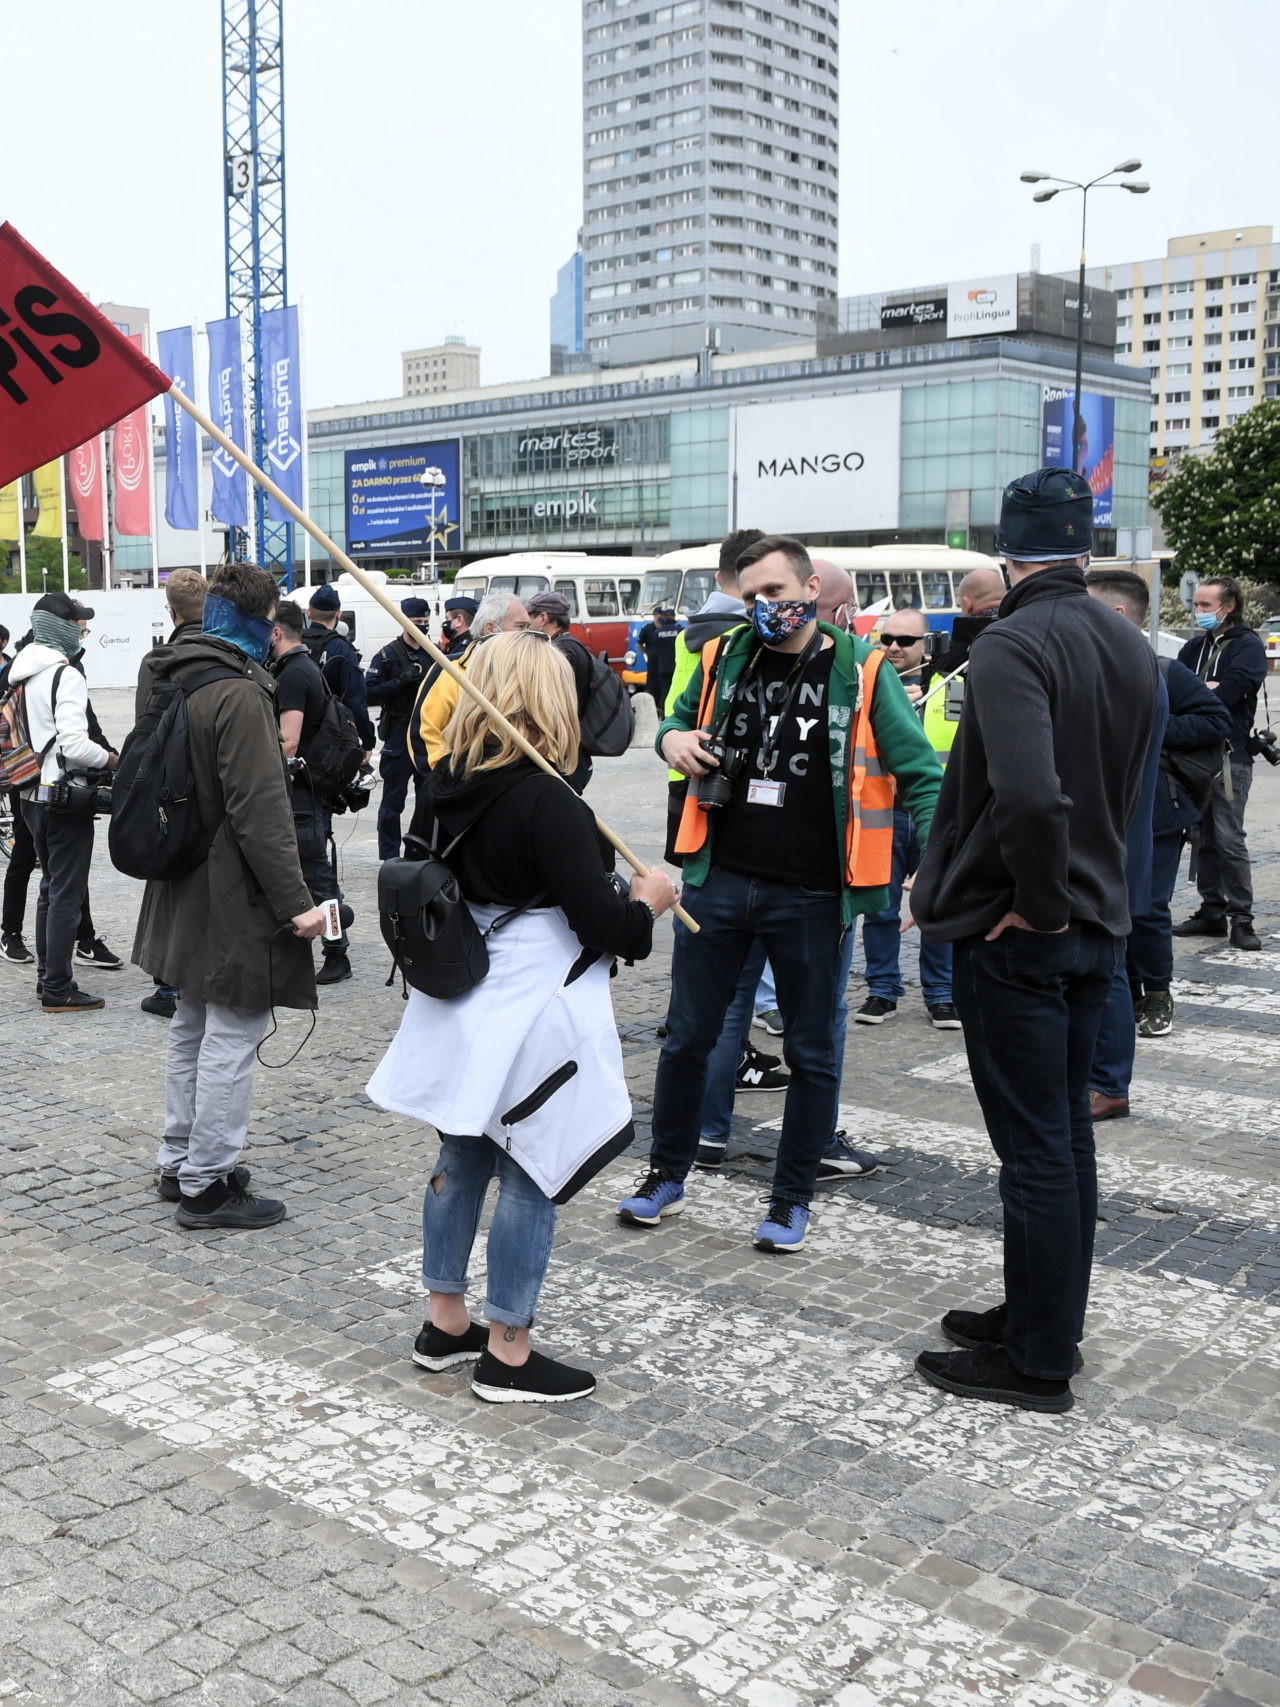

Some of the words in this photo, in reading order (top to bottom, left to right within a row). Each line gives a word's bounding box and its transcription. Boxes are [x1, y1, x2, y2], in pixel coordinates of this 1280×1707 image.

[237, 161, 250, 188] 3
[882, 303, 936, 319] martes
[913, 309, 945, 324] sport
[953, 308, 1011, 323] ProfiLingua
[520, 429, 600, 453] martes
[567, 441, 619, 464] sport
[351, 458, 377, 473] empik
[389, 456, 426, 470] premium
[758, 452, 865, 478] MANGO
[352, 479, 362, 488] ZA
[363, 476, 392, 487] DARMO
[393, 475, 412, 486] przez
[534, 490, 597, 519] empik
